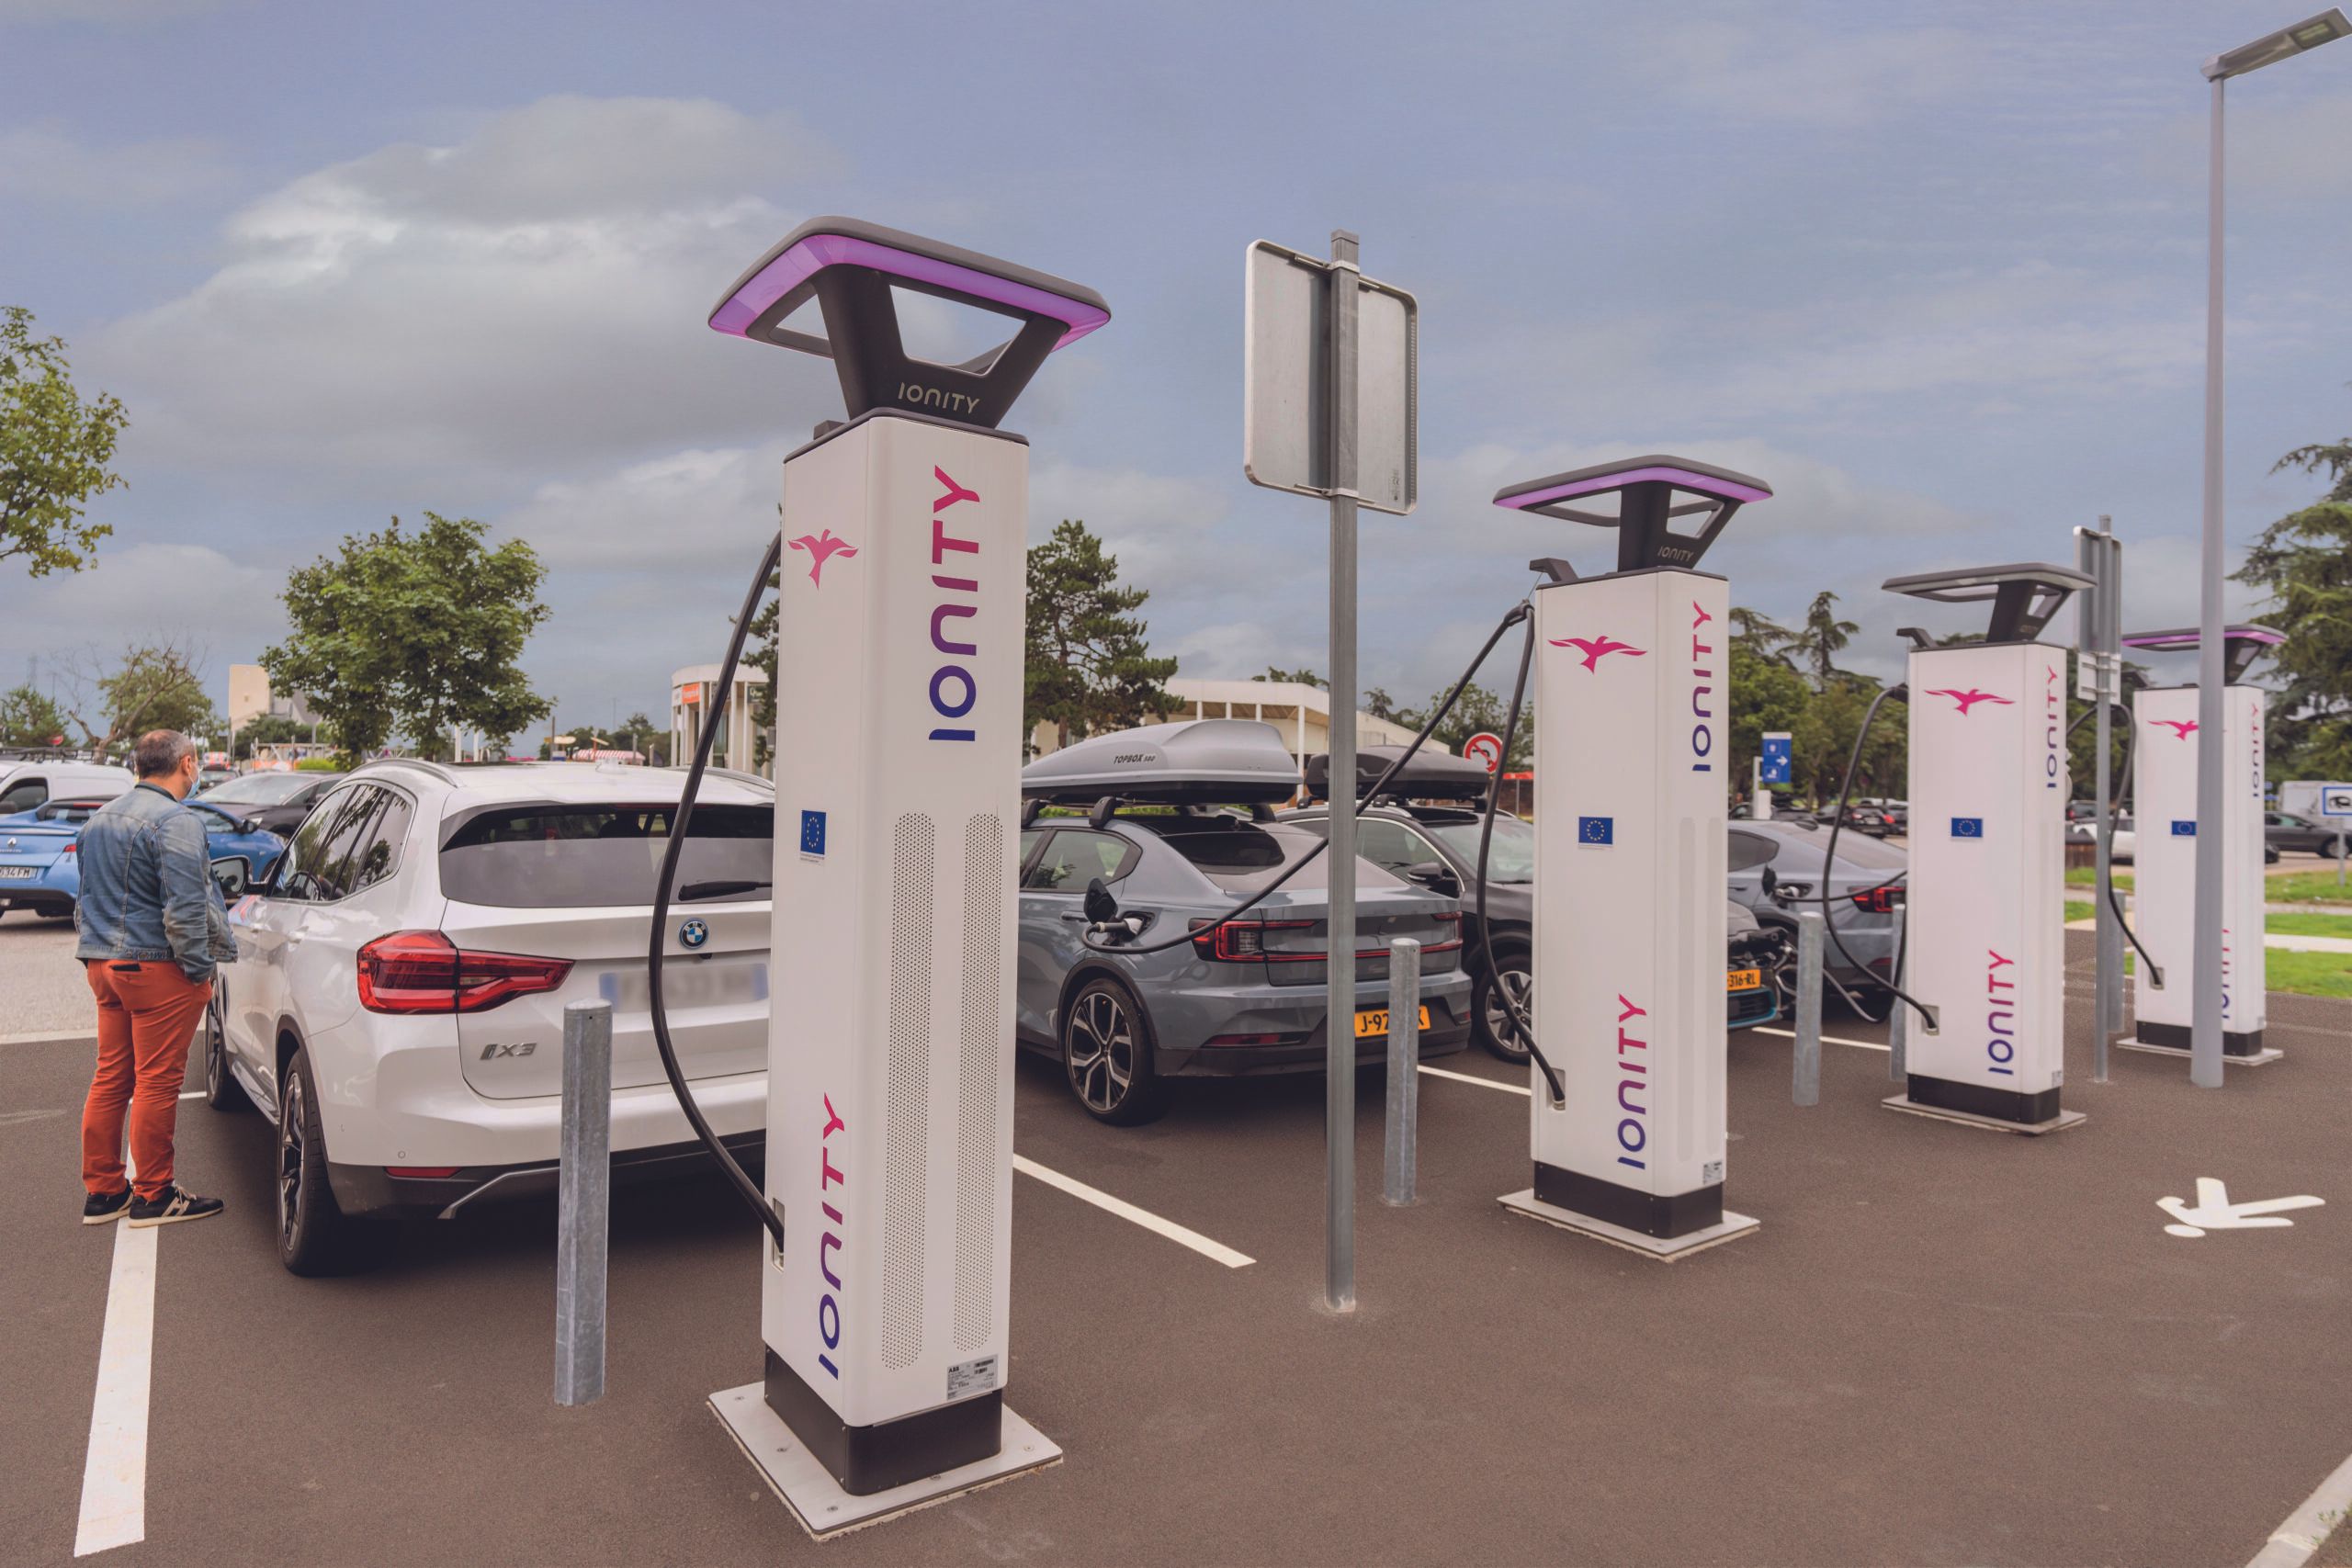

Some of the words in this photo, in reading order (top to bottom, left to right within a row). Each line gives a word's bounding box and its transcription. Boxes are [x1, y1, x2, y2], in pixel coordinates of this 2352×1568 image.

[898, 381, 980, 414] IONITY
[928, 464, 980, 741] IONITY
[1114, 753, 1145, 764] TOPBOX
[1692, 600, 1713, 772] IONITY
[2047, 664, 2058, 788] IONITY
[1617, 993, 1647, 1170] IONITY
[1988, 949, 2014, 1076] IONITY
[819, 1091, 845, 1381] IONITY
